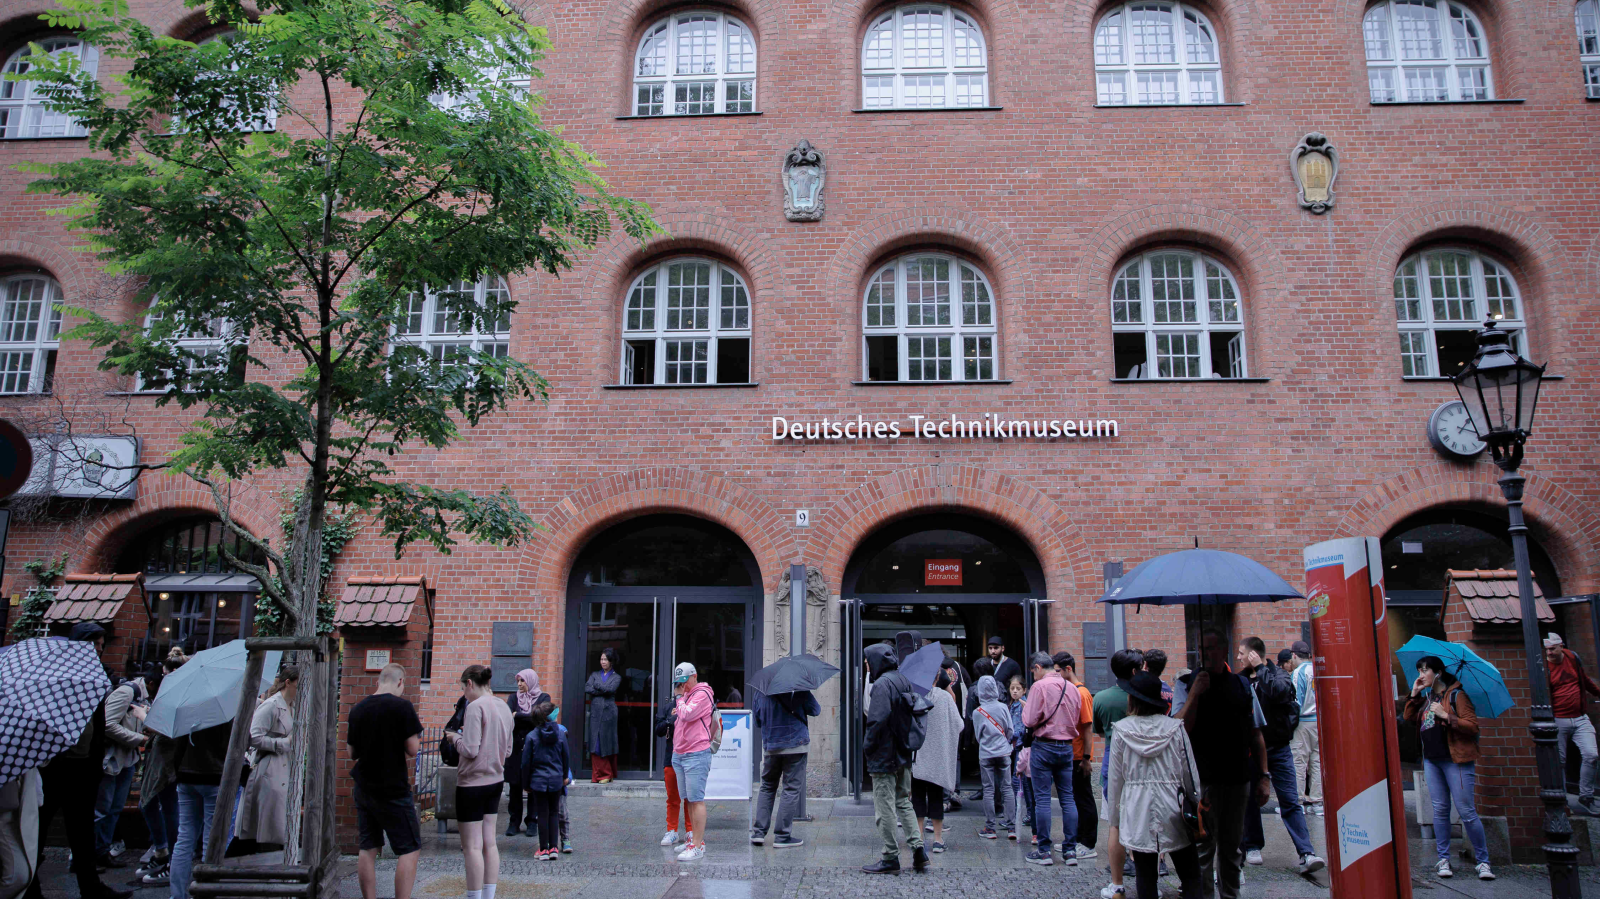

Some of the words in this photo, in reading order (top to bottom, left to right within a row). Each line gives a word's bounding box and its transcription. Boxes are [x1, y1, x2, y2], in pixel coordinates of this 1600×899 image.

[772, 414, 901, 440] Deutsches
[908, 412, 1119, 438] Technikmuseum
[799, 512, 806, 524] 9
[927, 563, 959, 573] Eingang
[927, 572, 959, 580] Entrance
[1346, 827, 1368, 838] Technik
[1346, 837, 1370, 845] museum
